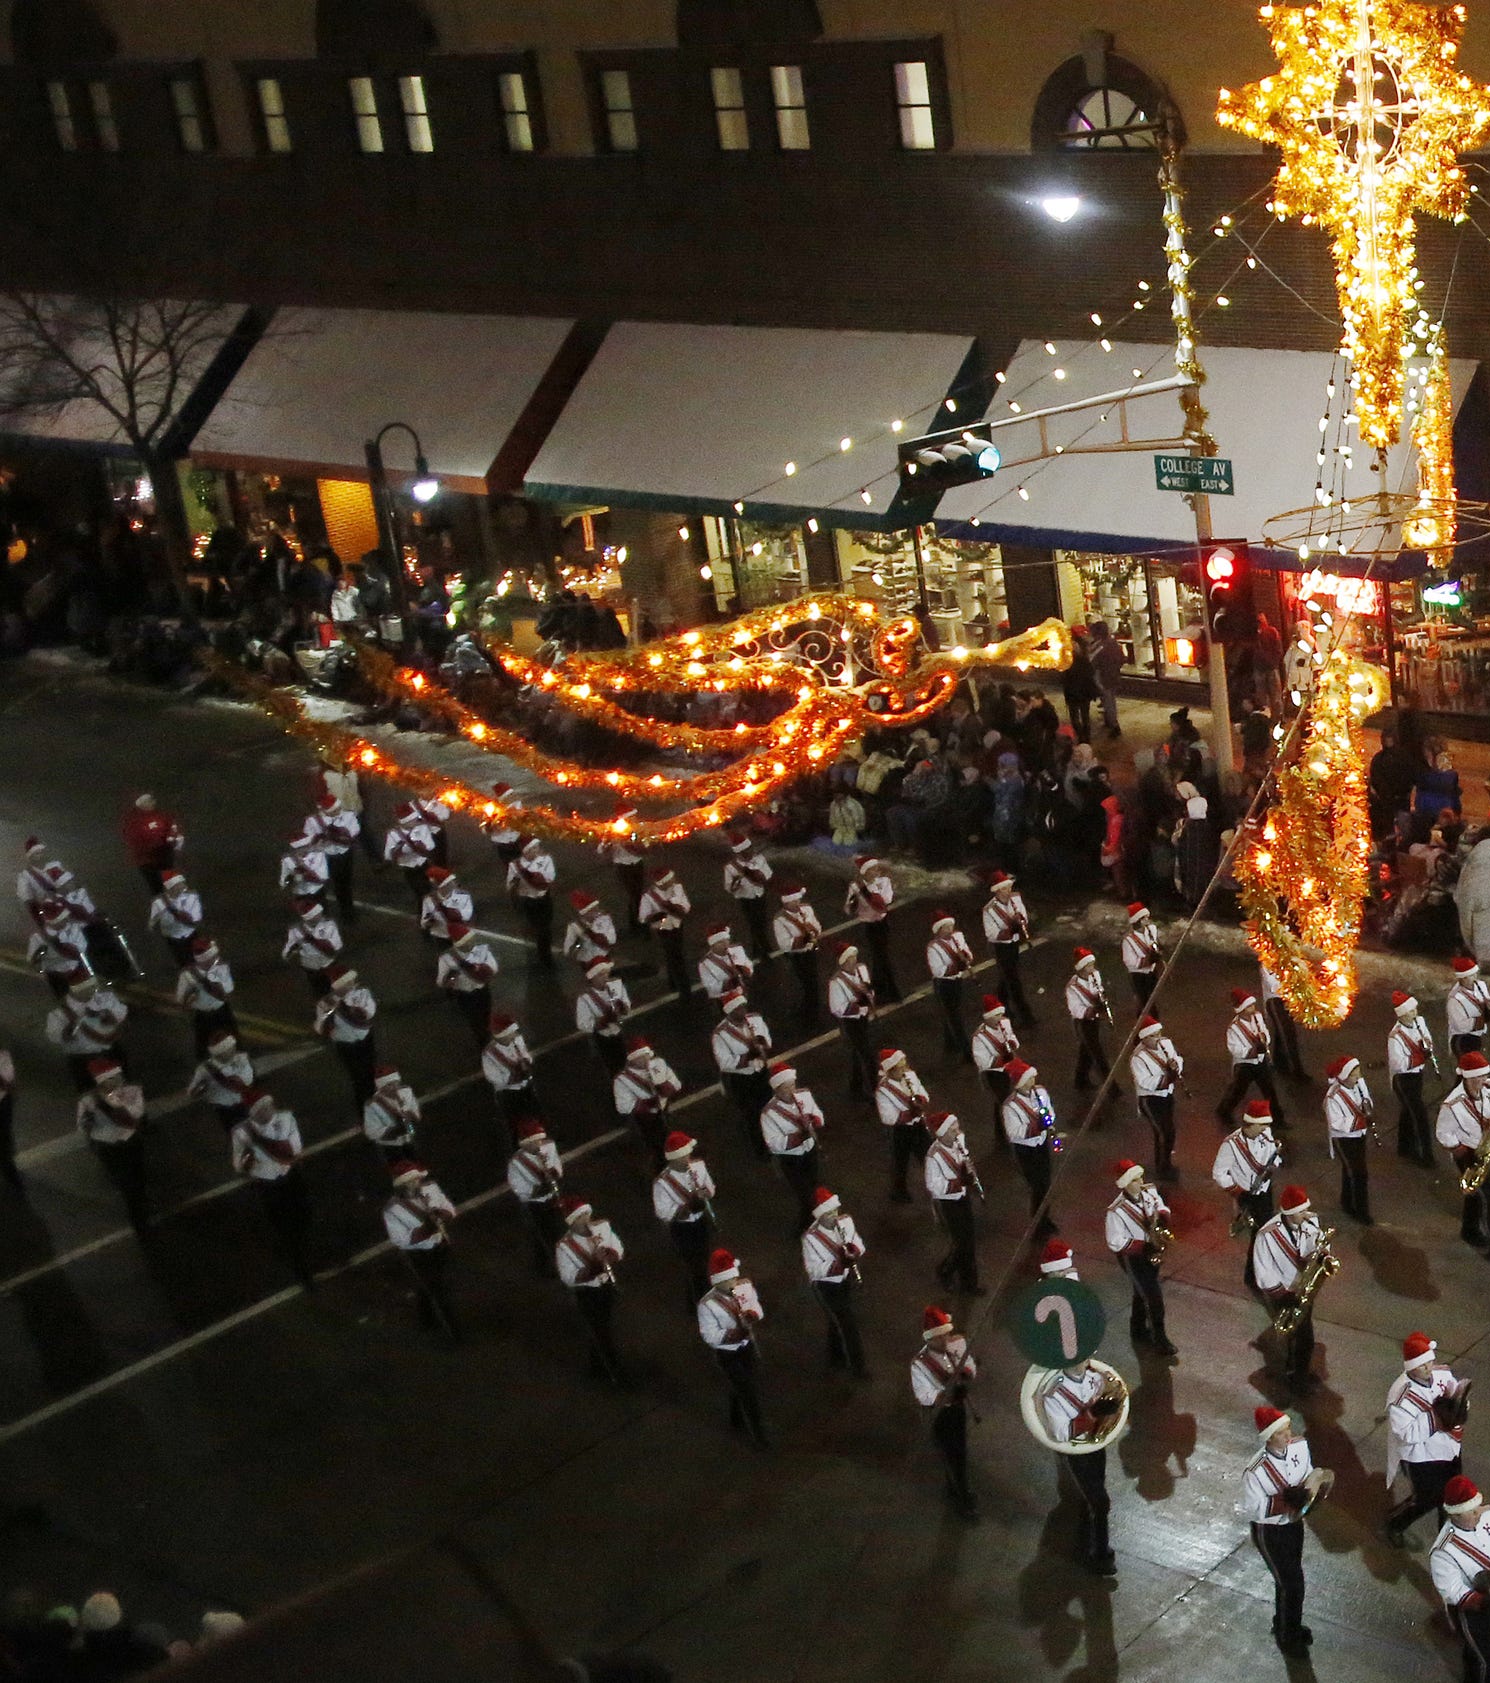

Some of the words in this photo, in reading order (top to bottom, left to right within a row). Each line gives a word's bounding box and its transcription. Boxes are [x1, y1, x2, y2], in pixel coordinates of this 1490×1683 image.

[1160, 458, 1204, 475] COLLEGE
[1212, 462, 1226, 476] AV
[1170, 476, 1189, 488] WEST
[1201, 479, 1217, 489] EAST
